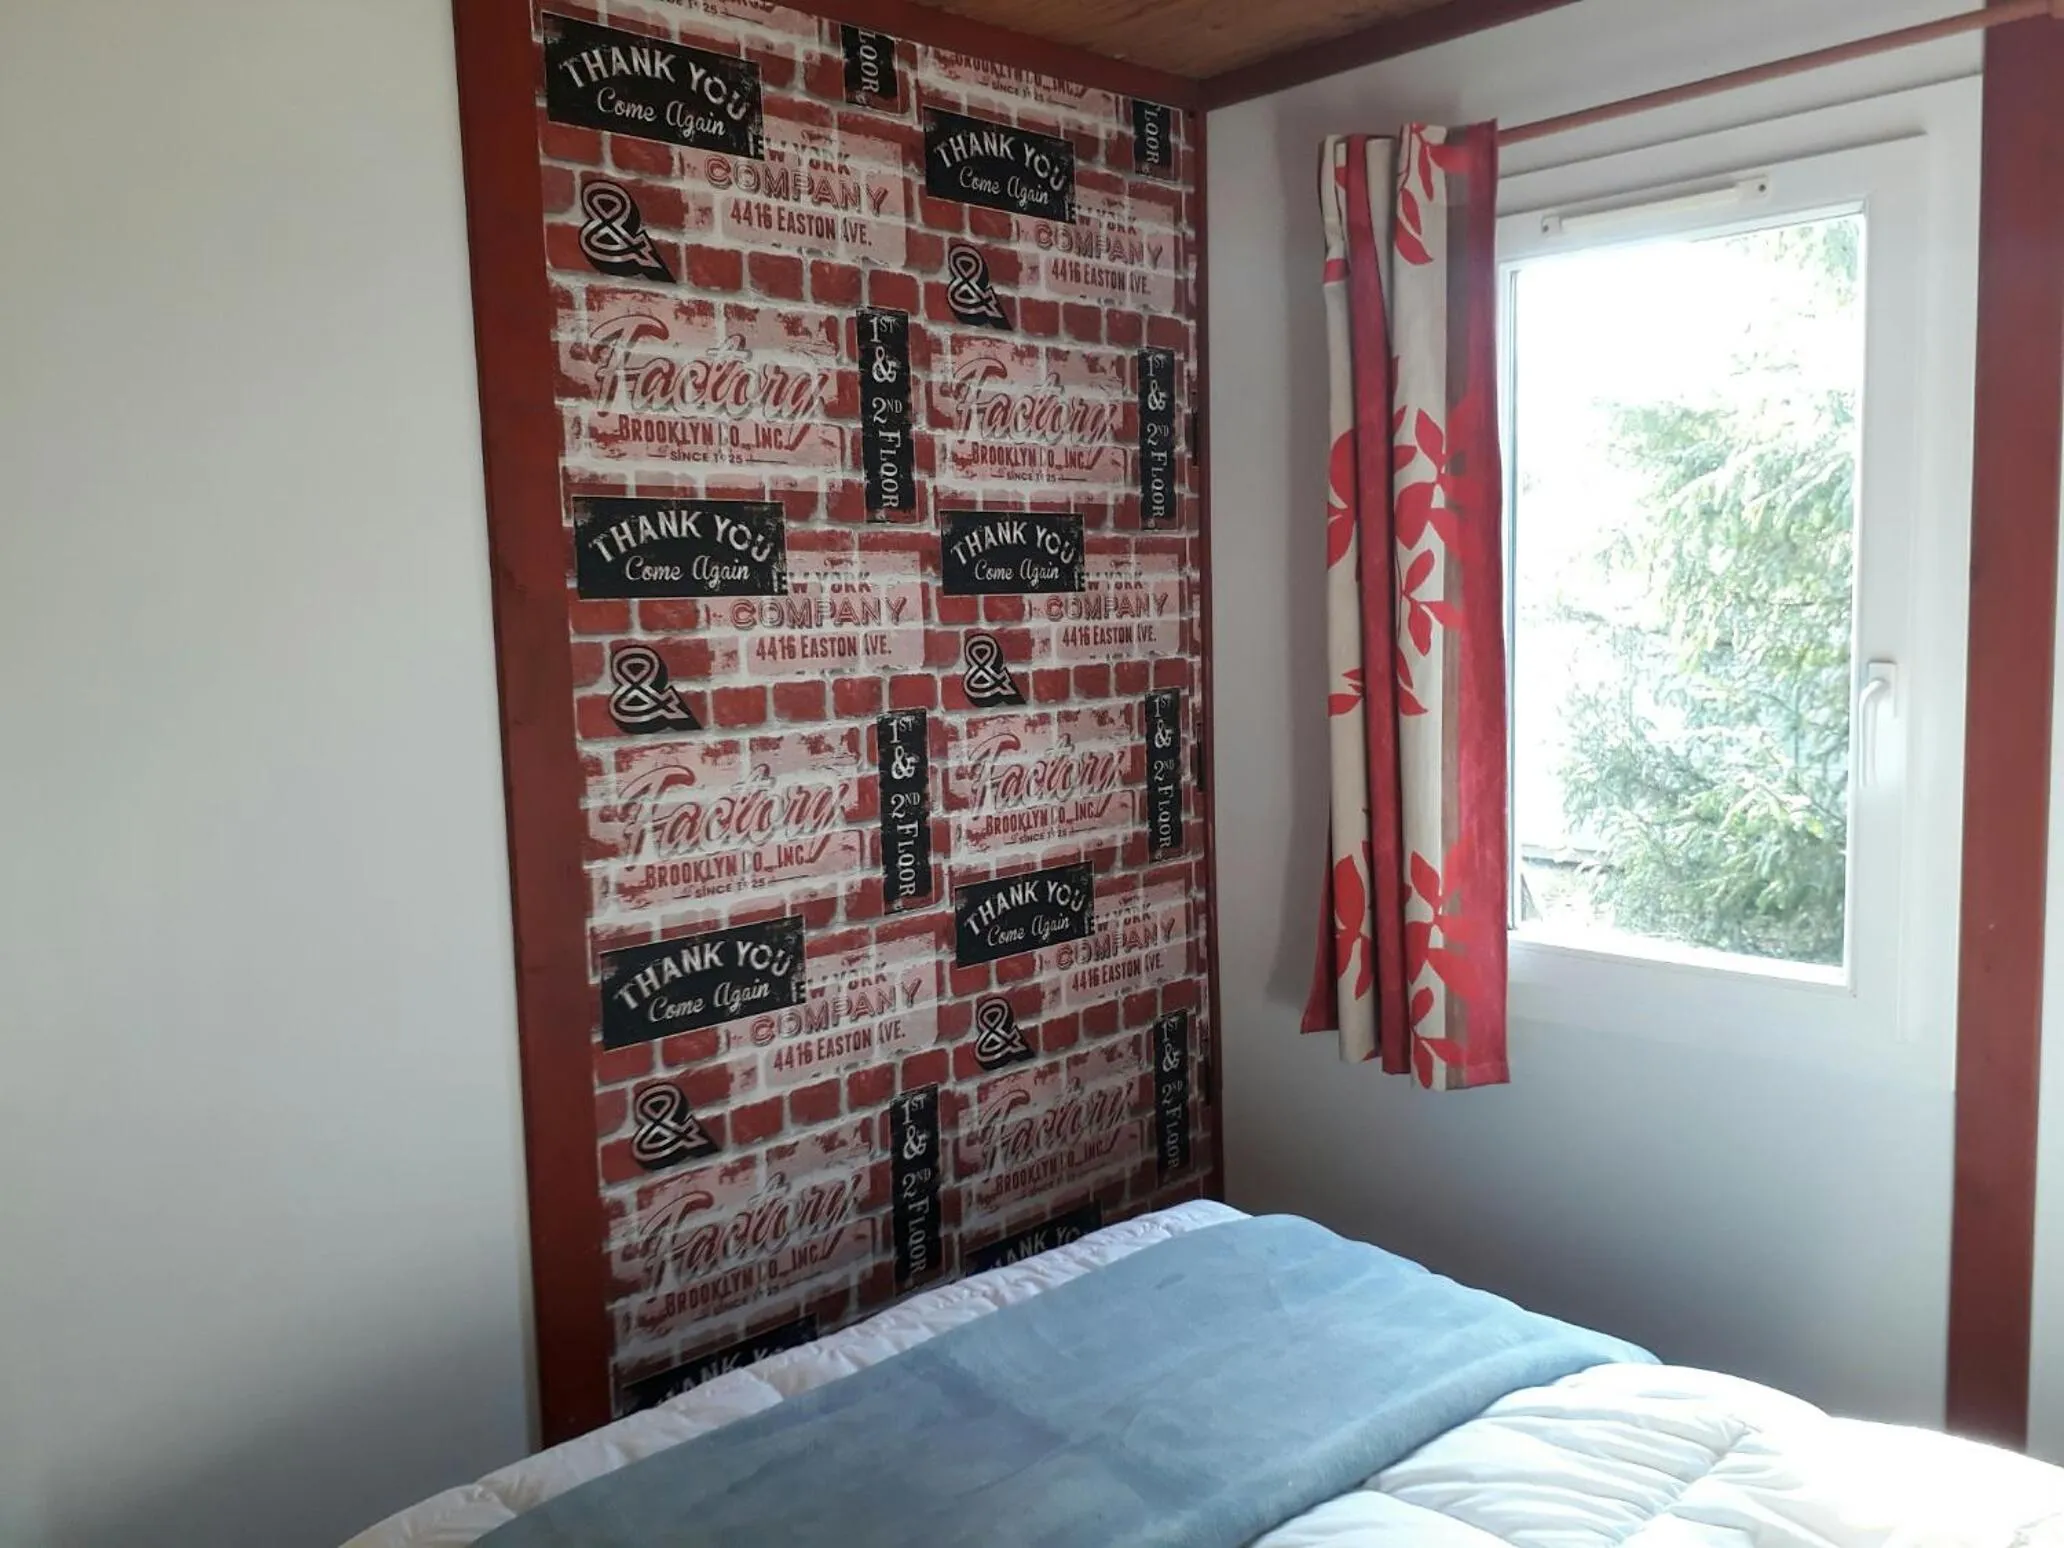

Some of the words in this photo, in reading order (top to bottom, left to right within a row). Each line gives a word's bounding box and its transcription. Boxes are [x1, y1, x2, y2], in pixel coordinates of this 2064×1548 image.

[559, 46, 676, 89] THANK
[688, 62, 748, 120] YOU
[858, 31, 881, 94] LOOR
[597, 87, 656, 121] Come
[666, 101, 726, 138] Again
[705, 154, 889, 217] COMPANY
[934, 131, 1015, 169] THANK
[1024, 142, 1067, 192] YOU
[959, 166, 1000, 194] Come
[1007, 175, 1049, 210] Again
[730, 198, 773, 229] 4416
[777, 206, 836, 240] EASTON
[1036, 223, 1163, 270] COMPANY
[1052, 259, 1081, 283] 4416
[1084, 263, 1126, 291] EASTON
[572, 313, 828, 422] Factory
[941, 357, 1118, 444] Factory
[619, 414, 713, 447] BROOKLYN
[972, 442, 1036, 467] BROOKLYN
[671, 450, 708, 463] SINCE
[879, 431, 901, 509] FLOOR
[1151, 451, 1168, 517] FLOOR
[589, 510, 703, 563] THANK
[714, 514, 774, 563] YOU
[951, 521, 1028, 565] THANK
[1035, 524, 1076, 565] YOU
[625, 555, 683, 581] Come
[693, 555, 750, 588] Again
[975, 559, 1014, 580] Come
[1021, 558, 1059, 588] Again
[731, 596, 908, 630] COMPANY
[1045, 592, 1168, 622] COMPANY
[756, 635, 796, 661] 4416
[801, 635, 858, 658] EASTON
[1062, 625, 1090, 647] 4416
[1093, 624, 1133, 645] EASTON
[956, 733, 1125, 808] Factory
[602, 763, 849, 863] Factory
[985, 807, 1048, 836] BROOKLYN
[1157, 783, 1173, 848] FLOOR
[645, 854, 737, 889] BROOKLYN
[897, 824, 919, 897] FLOOR
[695, 883, 732, 898] SINCE
[964, 880, 1039, 936] THANK
[1047, 880, 1085, 912] YOU
[987, 925, 1025, 947] Come
[1031, 914, 1070, 941] Again
[1055, 917, 1175, 970] COMPANY
[613, 941, 725, 1010] THANK
[736, 941, 792, 976] YOU
[1072, 967, 1099, 992] 4416
[1102, 957, 1141, 984] EASTON
[649, 996, 704, 1023] Come
[714, 978, 769, 1013] Again
[751, 978, 922, 1047] COMPANY
[773, 1040, 812, 1073] 4416
[817, 1027, 871, 1061] EASTON
[967, 1077, 1134, 1174] Factory
[1165, 1104, 1183, 1168] FLOOR
[995, 1160, 1058, 1191] BROOKLYN
[622, 1172, 862, 1290] Factory
[908, 1197, 929, 1273] FLOOR
[664, 1267, 753, 1319] BROOKLYN
